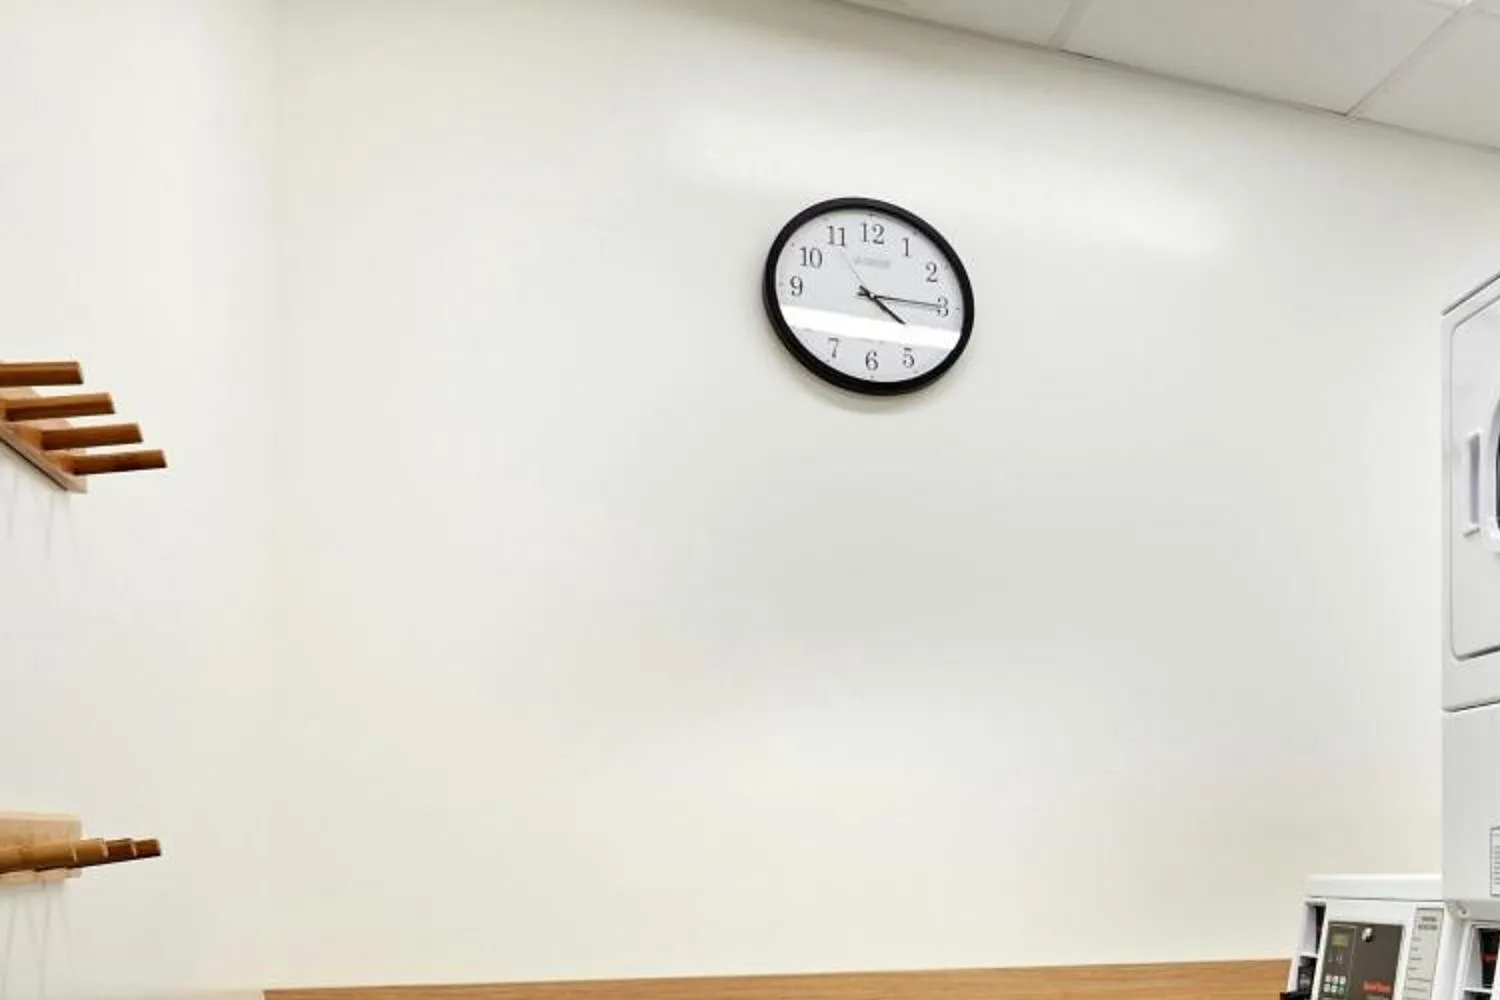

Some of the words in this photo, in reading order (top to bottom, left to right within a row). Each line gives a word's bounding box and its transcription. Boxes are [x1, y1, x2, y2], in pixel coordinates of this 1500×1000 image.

[826, 225, 846, 247] 11
[860, 223, 885, 245] 12
[799, 247, 823, 269] 10
[902, 237, 912, 257] 1
[926, 262, 938, 283] 2
[789, 275, 804, 297] 9
[827, 337, 840, 359] 7
[902, 347, 915, 368] 5
[864, 351, 879, 371] 6
